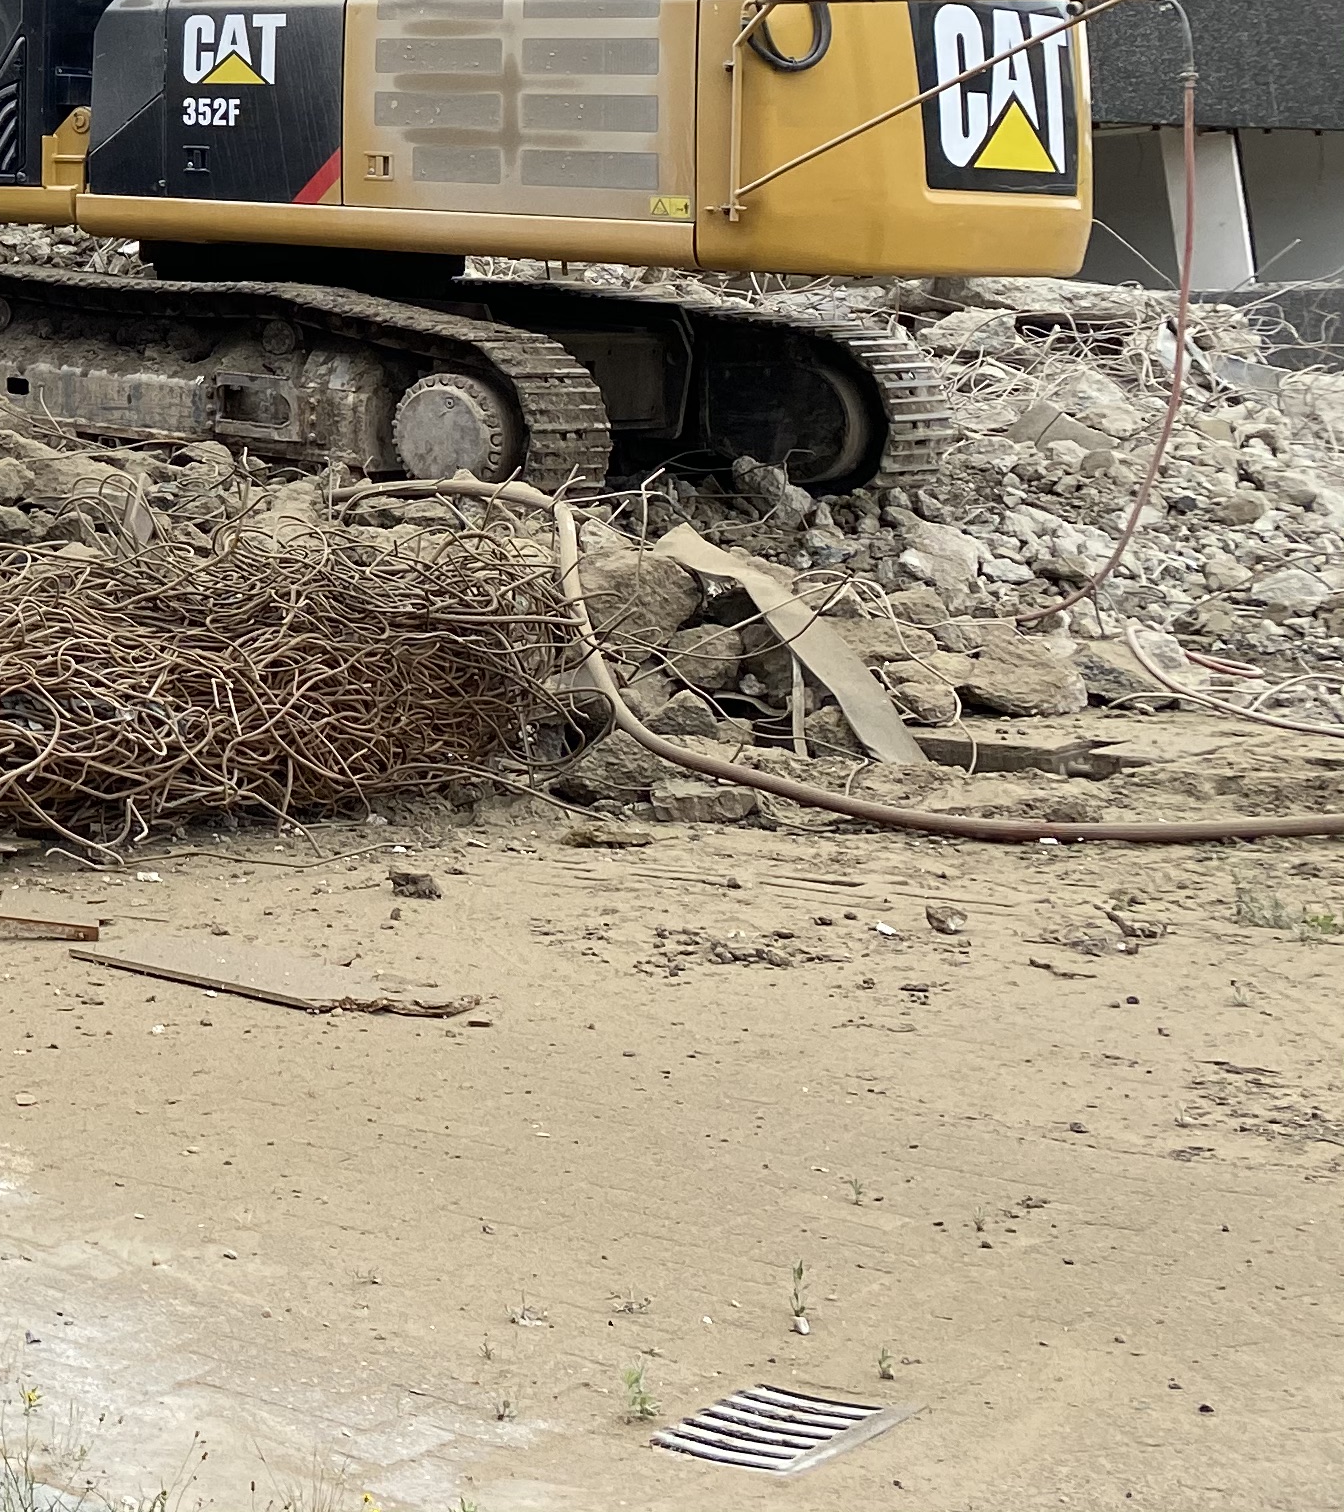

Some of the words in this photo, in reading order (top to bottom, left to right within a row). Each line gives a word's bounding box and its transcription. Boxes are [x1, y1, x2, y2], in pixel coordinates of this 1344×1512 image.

[182, 13, 287, 85] CAT
[182, 97, 241, 126] 352F
[933, 3, 1069, 174] CAT
